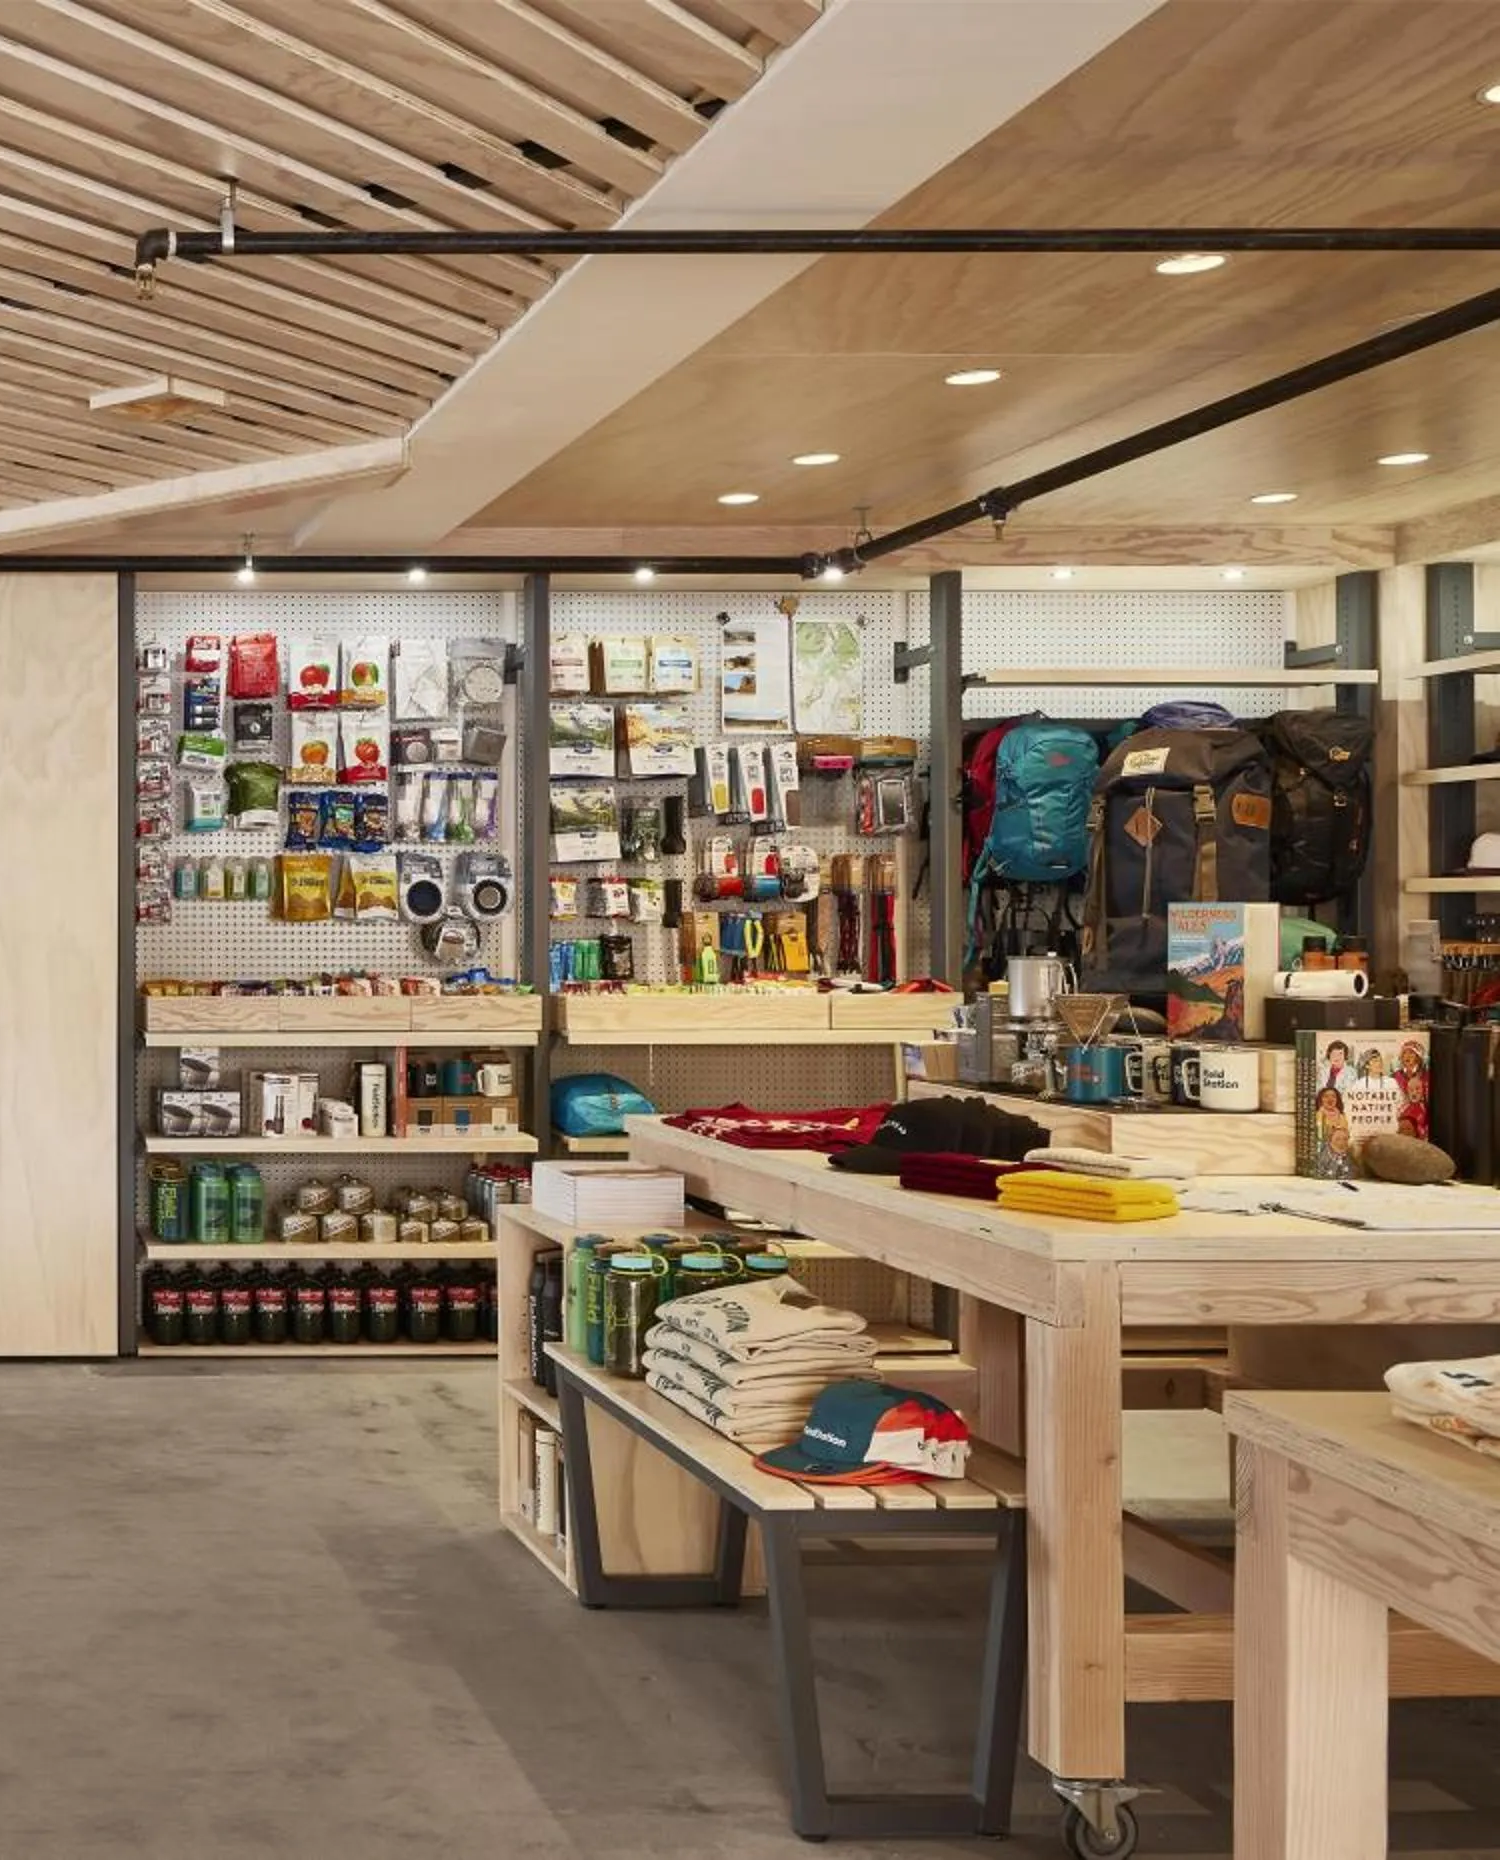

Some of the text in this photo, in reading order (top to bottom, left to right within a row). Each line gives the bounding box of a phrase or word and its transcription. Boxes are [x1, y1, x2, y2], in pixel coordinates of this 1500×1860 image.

[1347, 1091, 1397, 1101] NOTABLE
[1351, 1103, 1393, 1112] NATIVE
[1351, 1115, 1392, 1125] PEOPLE
